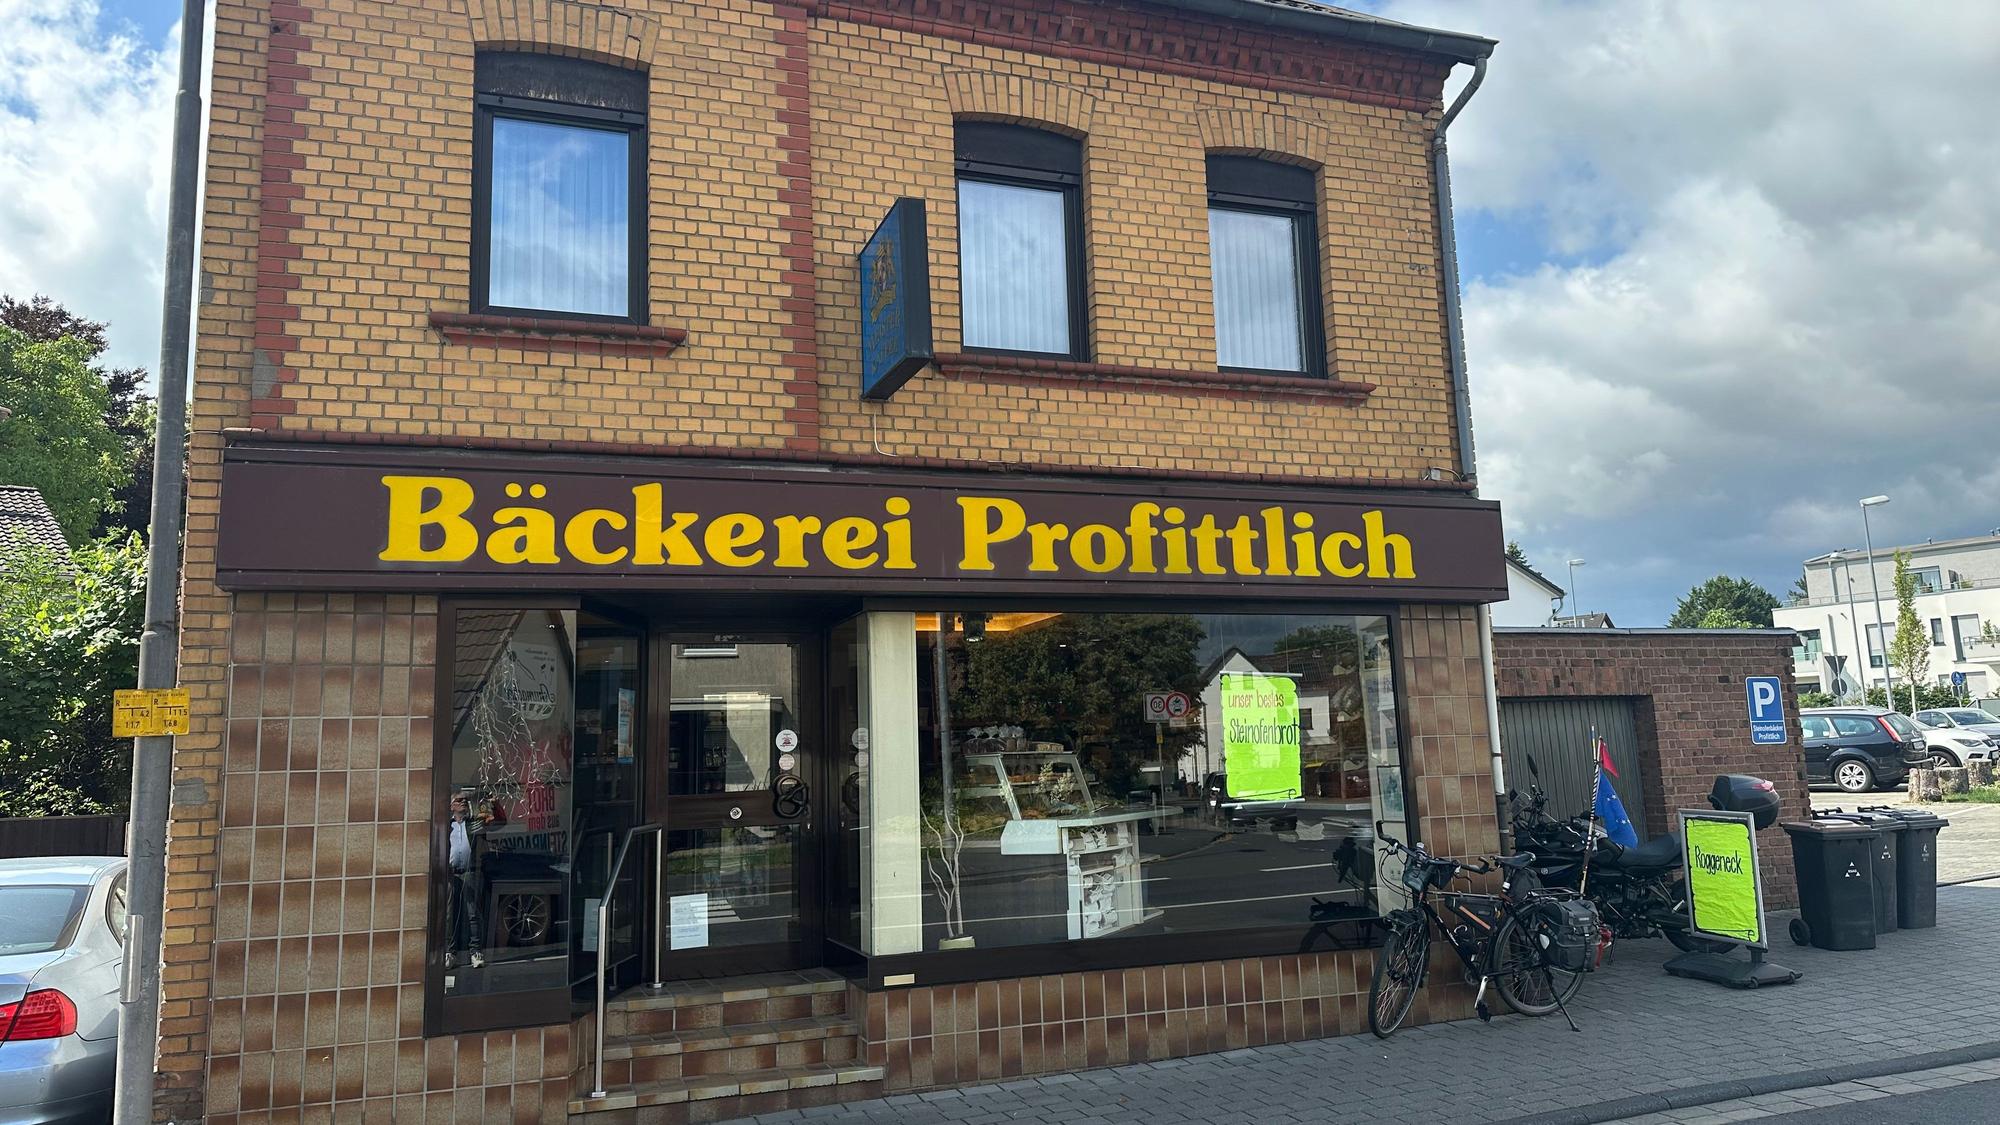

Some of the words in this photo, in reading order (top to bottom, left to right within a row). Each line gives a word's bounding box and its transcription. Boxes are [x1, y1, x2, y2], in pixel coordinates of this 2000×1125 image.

[378, 475, 917, 569] Bäckerei
[956, 496, 1416, 578] Profittlich
[1228, 693, 1254, 709] unser
[1256, 689, 1285, 708] bestes
[1752, 681, 1775, 718] P
[1229, 717, 1298, 745] Steinofenbrot
[1694, 845, 1744, 876] Roggeneck
